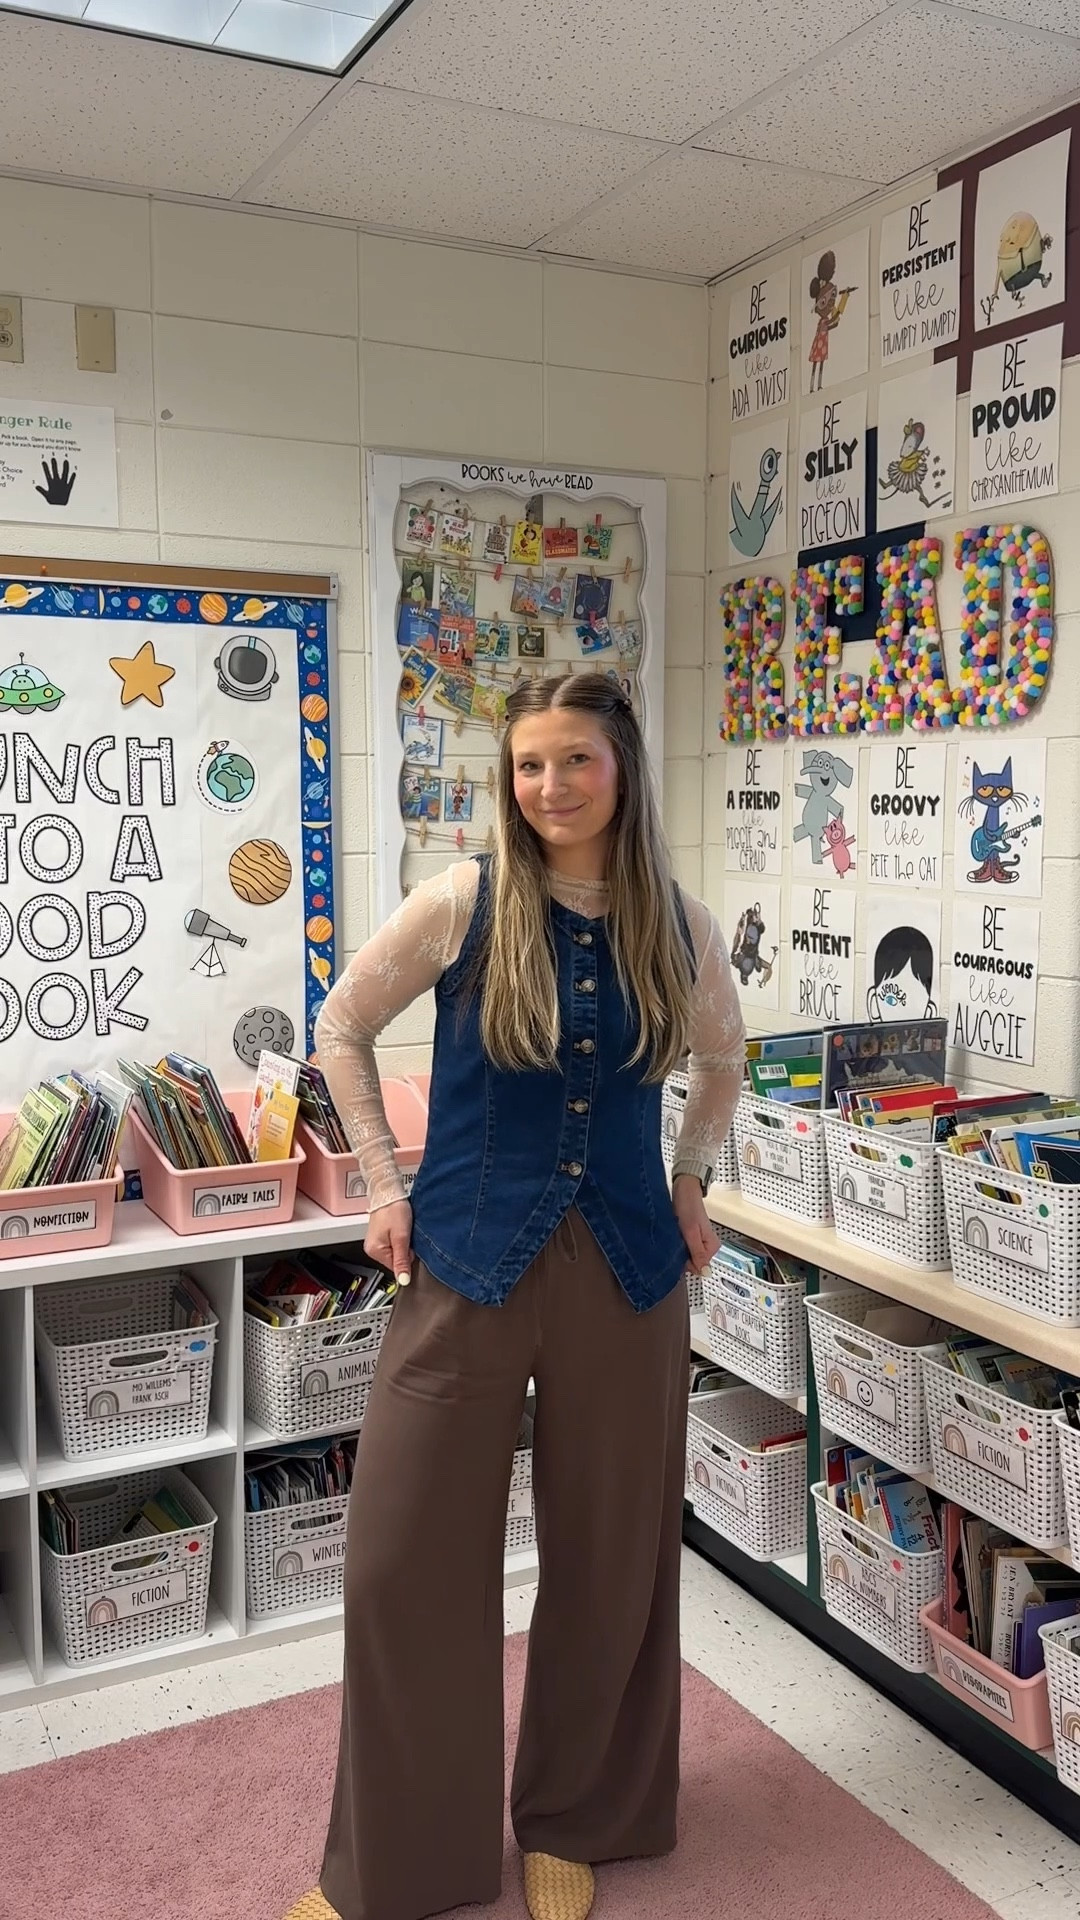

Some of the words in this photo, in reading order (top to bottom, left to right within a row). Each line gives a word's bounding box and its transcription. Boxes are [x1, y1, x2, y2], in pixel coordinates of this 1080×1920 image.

[908, 199, 931, 251] BE
[882, 241, 956, 287] PERSISTENT
[750, 280, 768, 324] BE
[893, 280, 944, 321] like
[729, 317, 788, 359] CURIOUS
[883, 323, 917, 357] HUMPTY
[921, 308, 957, 344] DUMPTY
[744, 356, 772, 379] like
[1002, 339, 1028, 392] BE
[731, 388, 750, 420] ADA
[756, 368, 789, 407] TWIST
[972, 386, 1056, 437] PROUD
[38, 416, 73, 430] Rule
[822, 401, 842, 446] BE
[805, 438, 858, 482] SILLY
[984, 431, 1041, 471] like
[507, 471, 527, 484] we
[529, 470, 563, 488] have
[564, 474, 593, 490] READ
[815, 476, 846, 501] like
[971, 463, 1055, 503] CHRYSANTHEMUM
[802, 497, 860, 547] PIGEON
[719, 523, 1055, 742] READ
[0, 733, 176, 805] NCH
[745, 749, 763, 786] BE
[895, 747, 917, 789] BE
[727, 790, 735, 810] A
[739, 790, 780, 811] FRIEND
[870, 794, 941, 817] GROOVY
[110, 815, 163, 883] A
[727, 827, 754, 850] PIGGIE
[757, 826, 777, 850] and
[884, 822, 924, 847] like
[739, 849, 767, 873] GERALD
[870, 853, 889, 879] PETE
[894, 854, 914, 881] the
[919, 856, 938, 882] CAT
[0, 891, 147, 962] OD
[813, 888, 832, 928] BE
[792, 929, 852, 959] PATIENT
[982, 905, 1007, 952] BE
[804, 956, 840, 981] like
[954, 951, 1034, 979] COURAGOUS
[799, 979, 842, 1022] BRUCE
[969, 975, 1015, 1008] like
[955, 1004, 1027, 1060] AUGGIE
[222, 1192, 249, 1207] FAIRY
[252, 1189, 275, 1204] TALES
[33, 1211, 90, 1229] NONFICTION
[998, 1227, 1034, 1257] SCIENCE
[132, 1383, 143, 1393] MO
[146, 1378, 172, 1391] WILLEMS
[338, 1360, 376, 1382] ANIMALS
[132, 1393, 151, 1404] FRANK
[154, 1391, 169, 1402] ASCH
[977, 1441, 1011, 1474] FICTION
[715, 1475, 737, 1500] FICTION
[921, 1514, 940, 1551] Fract
[312, 1542, 347, 1563] WINTER
[131, 1584, 171, 1607] FICTION
